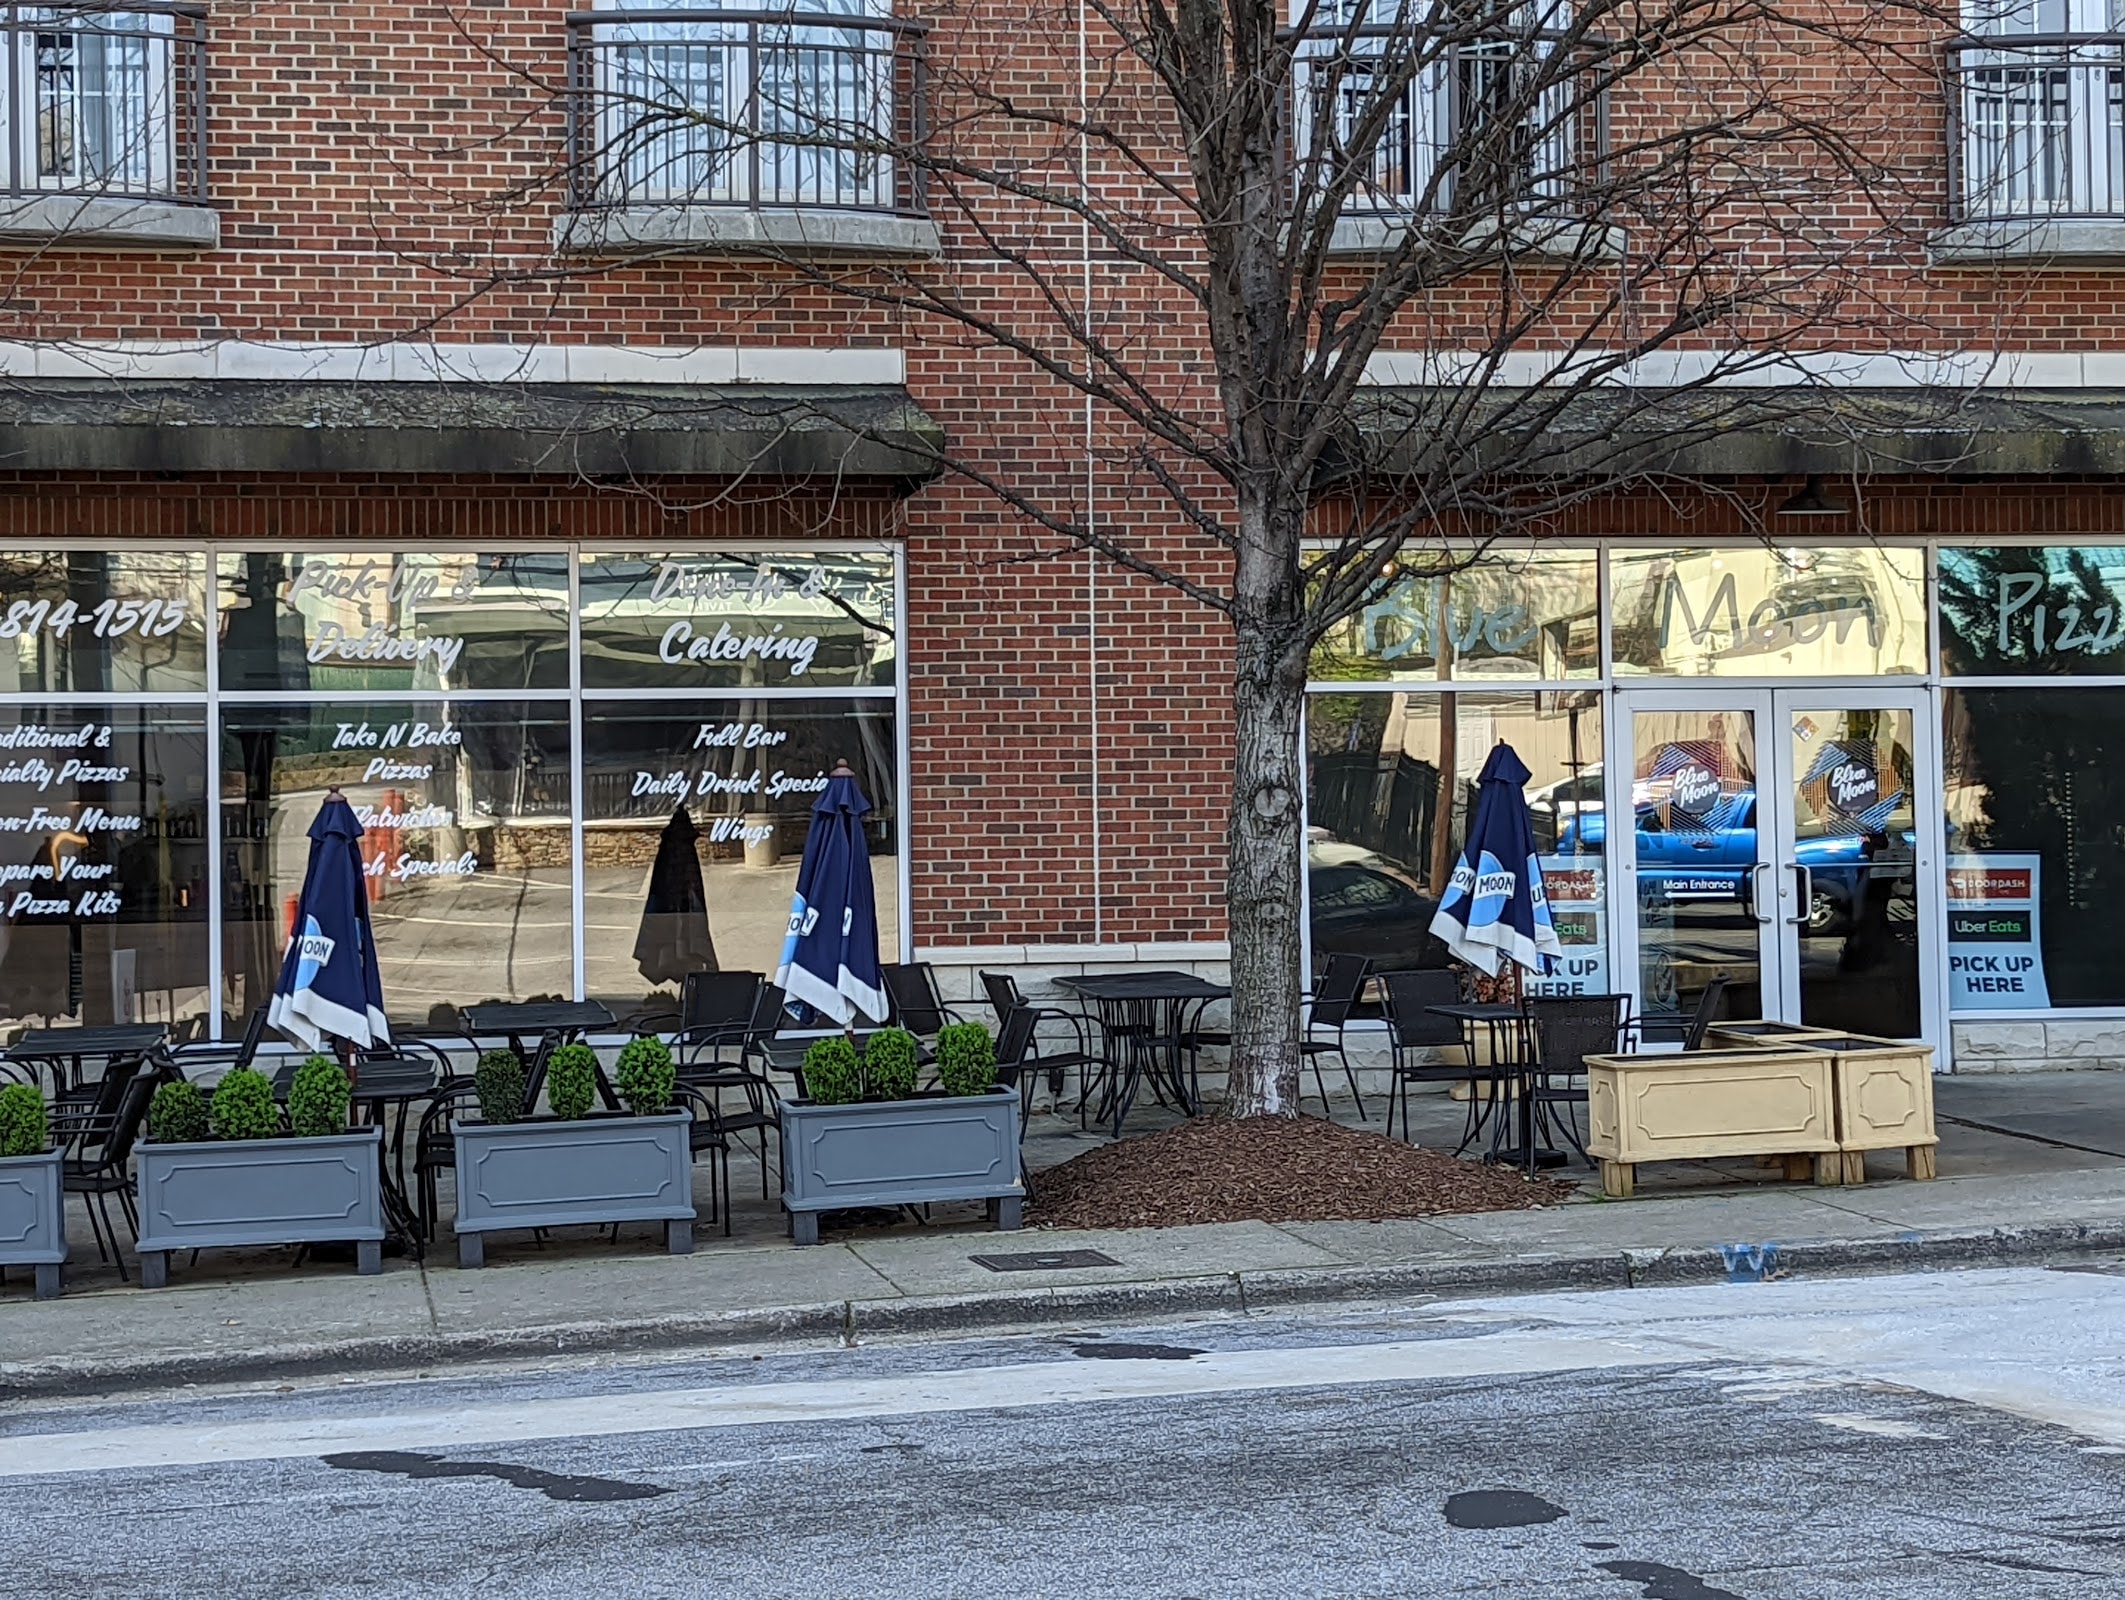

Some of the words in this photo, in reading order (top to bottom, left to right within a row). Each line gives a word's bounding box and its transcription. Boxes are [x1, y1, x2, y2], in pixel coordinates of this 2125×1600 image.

[287, 558, 438, 608] Pick-Up
[451, 563, 479, 600] &
[650, 562, 787, 602] Dine-In
[800, 564, 825, 599] &
[0, 599, 189, 638] 814-1515
[1659, 572, 1886, 650] Moon
[306, 621, 464, 675] Delivery
[659, 621, 819, 676] Catering
[94, 726, 112, 747] &
[332, 722, 377, 749] Take
[378, 722, 409, 750] N
[408, 722, 462, 748] Bake
[693, 723, 744, 749] Full
[743, 723, 787, 748] Bar
[0, 758, 54, 792] ialty
[56, 759, 129, 785] Pizzas
[362, 757, 433, 783] Pizzas
[1674, 766, 1709, 789] Blue
[1831, 764, 1867, 787] Blue
[632, 771, 692, 804] Daily
[697, 769, 761, 795] Drink
[765, 770, 829, 800] Specia
[1680, 782, 1719, 808] Moon
[1837, 779, 1877, 805] Moon
[74, 807, 141, 833] Menu
[709, 817, 774, 848] Wings
[56, 855, 112, 882] Your
[390, 851, 478, 881] Specials
[1479, 876, 1513, 894] MOON
[1663, 880, 1688, 890] Main
[1690, 880, 1735, 890] Entrance
[8, 892, 70, 917] Pizza
[75, 890, 122, 916] Kits
[1954, 920, 1987, 933] Uber
[1988, 920, 2022, 933] Eats
[304, 940, 329, 958] OON
[1569, 959, 1599, 976] UP
[1951, 956, 2000, 972] PICK
[2005, 956, 2034, 972] UP
[1524, 982, 1584, 998] HERE
[1966, 977, 2025, 992] HERE
